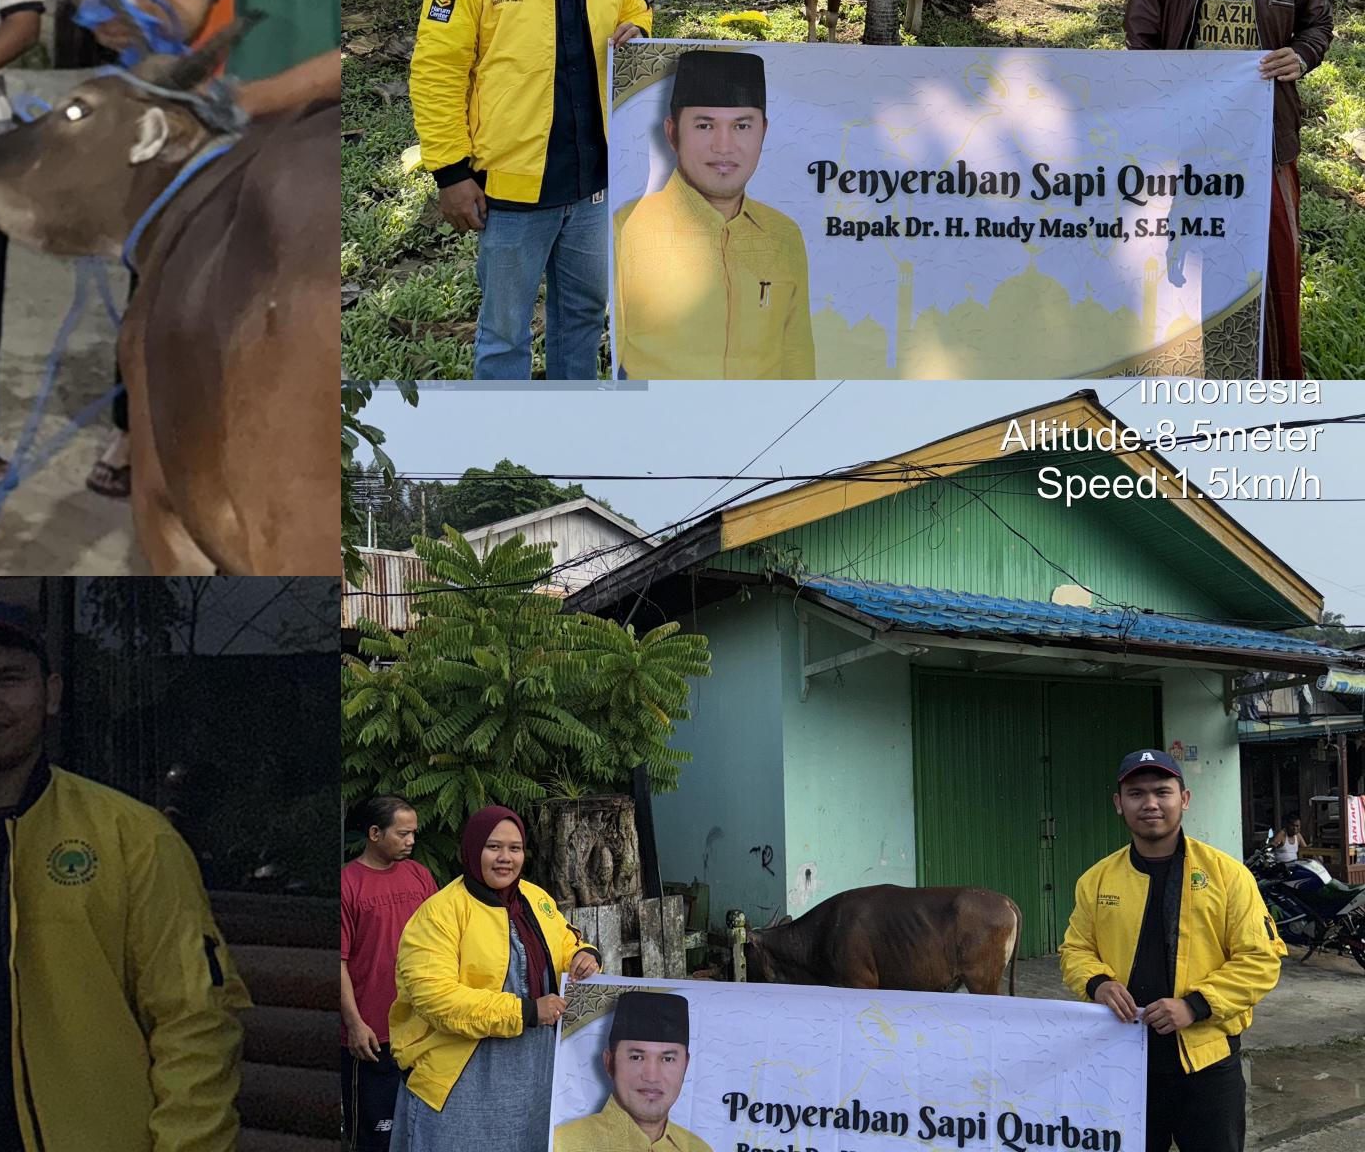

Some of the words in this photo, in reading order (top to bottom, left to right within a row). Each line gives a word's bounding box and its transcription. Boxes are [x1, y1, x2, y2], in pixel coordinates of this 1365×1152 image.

[1216, 4, 1256, 24] AZH
[808, 160, 1020, 203] Penyerahan
[1031, 163, 1105, 206] Sapi
[1118, 164, 1244, 206] Qurban
[826, 215, 900, 241] Bapak
[905, 217, 939, 237] Dr.
[945, 218, 969, 237] H.
[975, 216, 1035, 243] Rudy
[1134, 217, 1177, 240] S.E,
[1181, 217, 1225, 237] M.E
[1140, 752, 1155, 762] A
[722, 1092, 908, 1136] Penyerahan
[918, 1106, 985, 1148] Sapi
[997, 1112, 1121, 1152] Qurban
